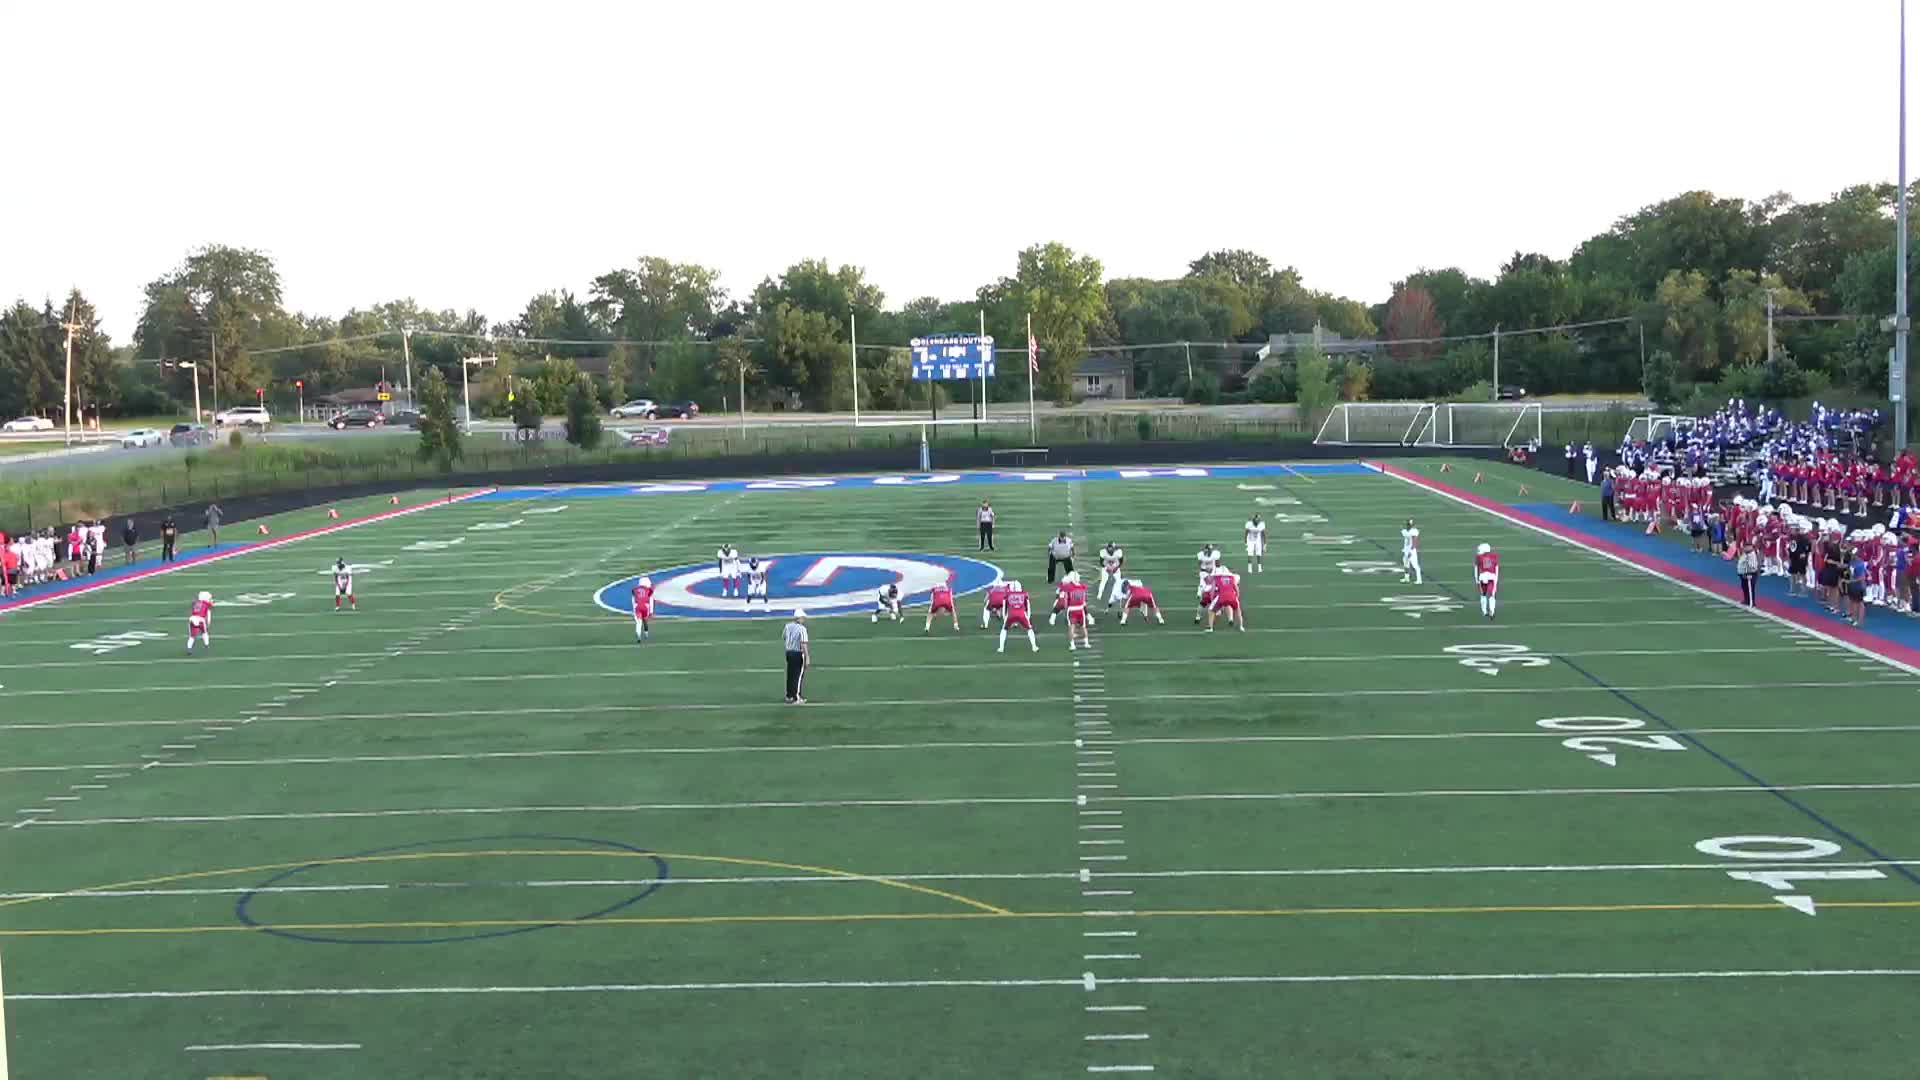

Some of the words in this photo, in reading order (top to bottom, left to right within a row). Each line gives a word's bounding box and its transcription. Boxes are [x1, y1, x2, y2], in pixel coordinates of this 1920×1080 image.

[1442, 643, 1550, 667] 30
[1536, 716, 1688, 752] 20
[1695, 835, 1888, 891] 10
